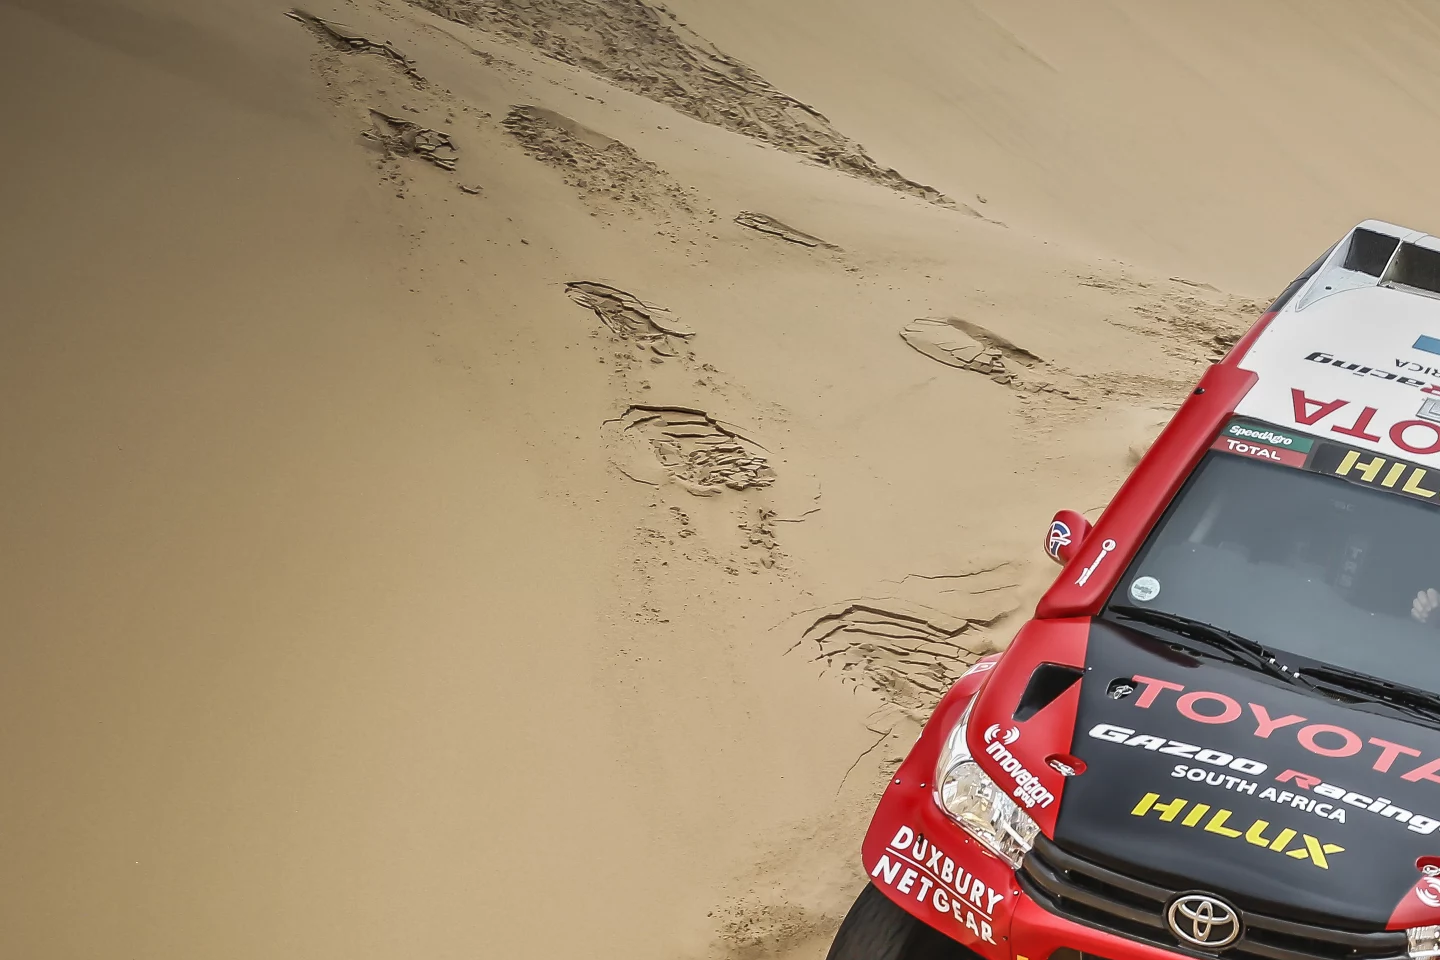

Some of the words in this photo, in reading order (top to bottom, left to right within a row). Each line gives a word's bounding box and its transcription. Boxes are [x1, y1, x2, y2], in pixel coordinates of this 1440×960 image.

[1226, 439, 1281, 461] TOTAL
[1229, 425, 1293, 445] SpeedAgro
[986, 741, 1055, 808] innovation
[1088, 723, 1268, 776] GAZOO
[1013, 787, 1036, 808] group
[1171, 764, 1258, 796] SOUTH
[1258, 787, 1347, 824] AFRICA
[1130, 792, 1346, 870] HILUX
[871, 854, 998, 946] NETGEAR
[890, 825, 1004, 915] DUXBURY
